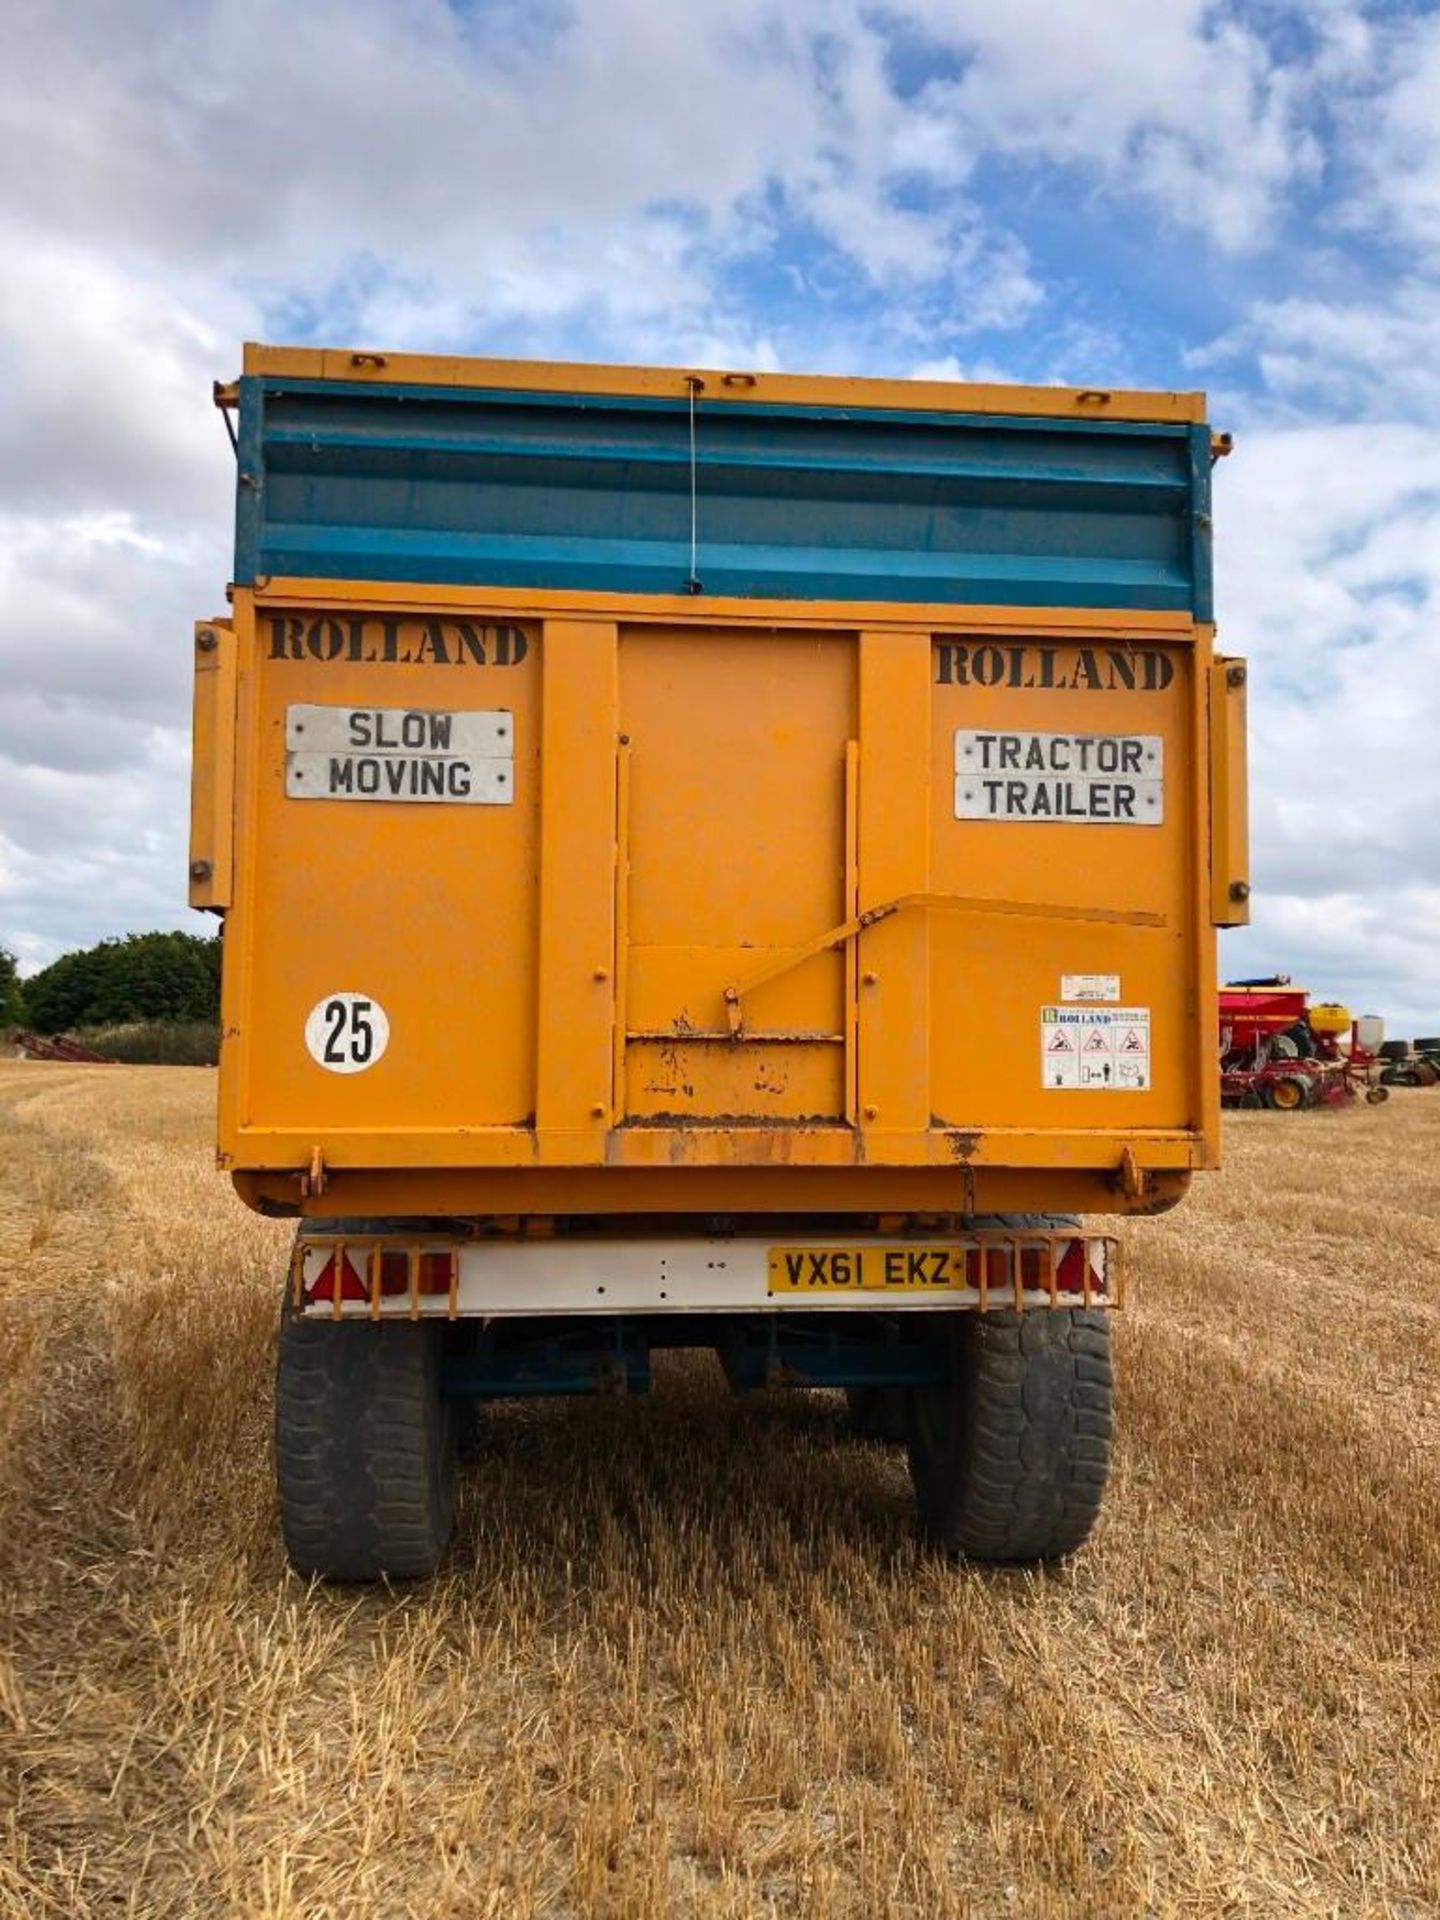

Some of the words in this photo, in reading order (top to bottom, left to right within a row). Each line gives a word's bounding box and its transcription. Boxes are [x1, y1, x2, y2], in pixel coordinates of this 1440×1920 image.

[267, 616, 528, 666] ROLLAND
[935, 644, 1174, 690] ROLLAND
[350, 712, 452, 749] SLOW
[975, 735, 1143, 773] TRACTOR
[329, 758, 471, 796] MOVING
[982, 781, 1136, 817] TRAILER
[324, 1000, 373, 1063] 25
[1059, 1014, 1112, 1024] ROLLAND
[785, 1253, 862, 1285] VX61
[885, 1253, 950, 1284] EKZ
